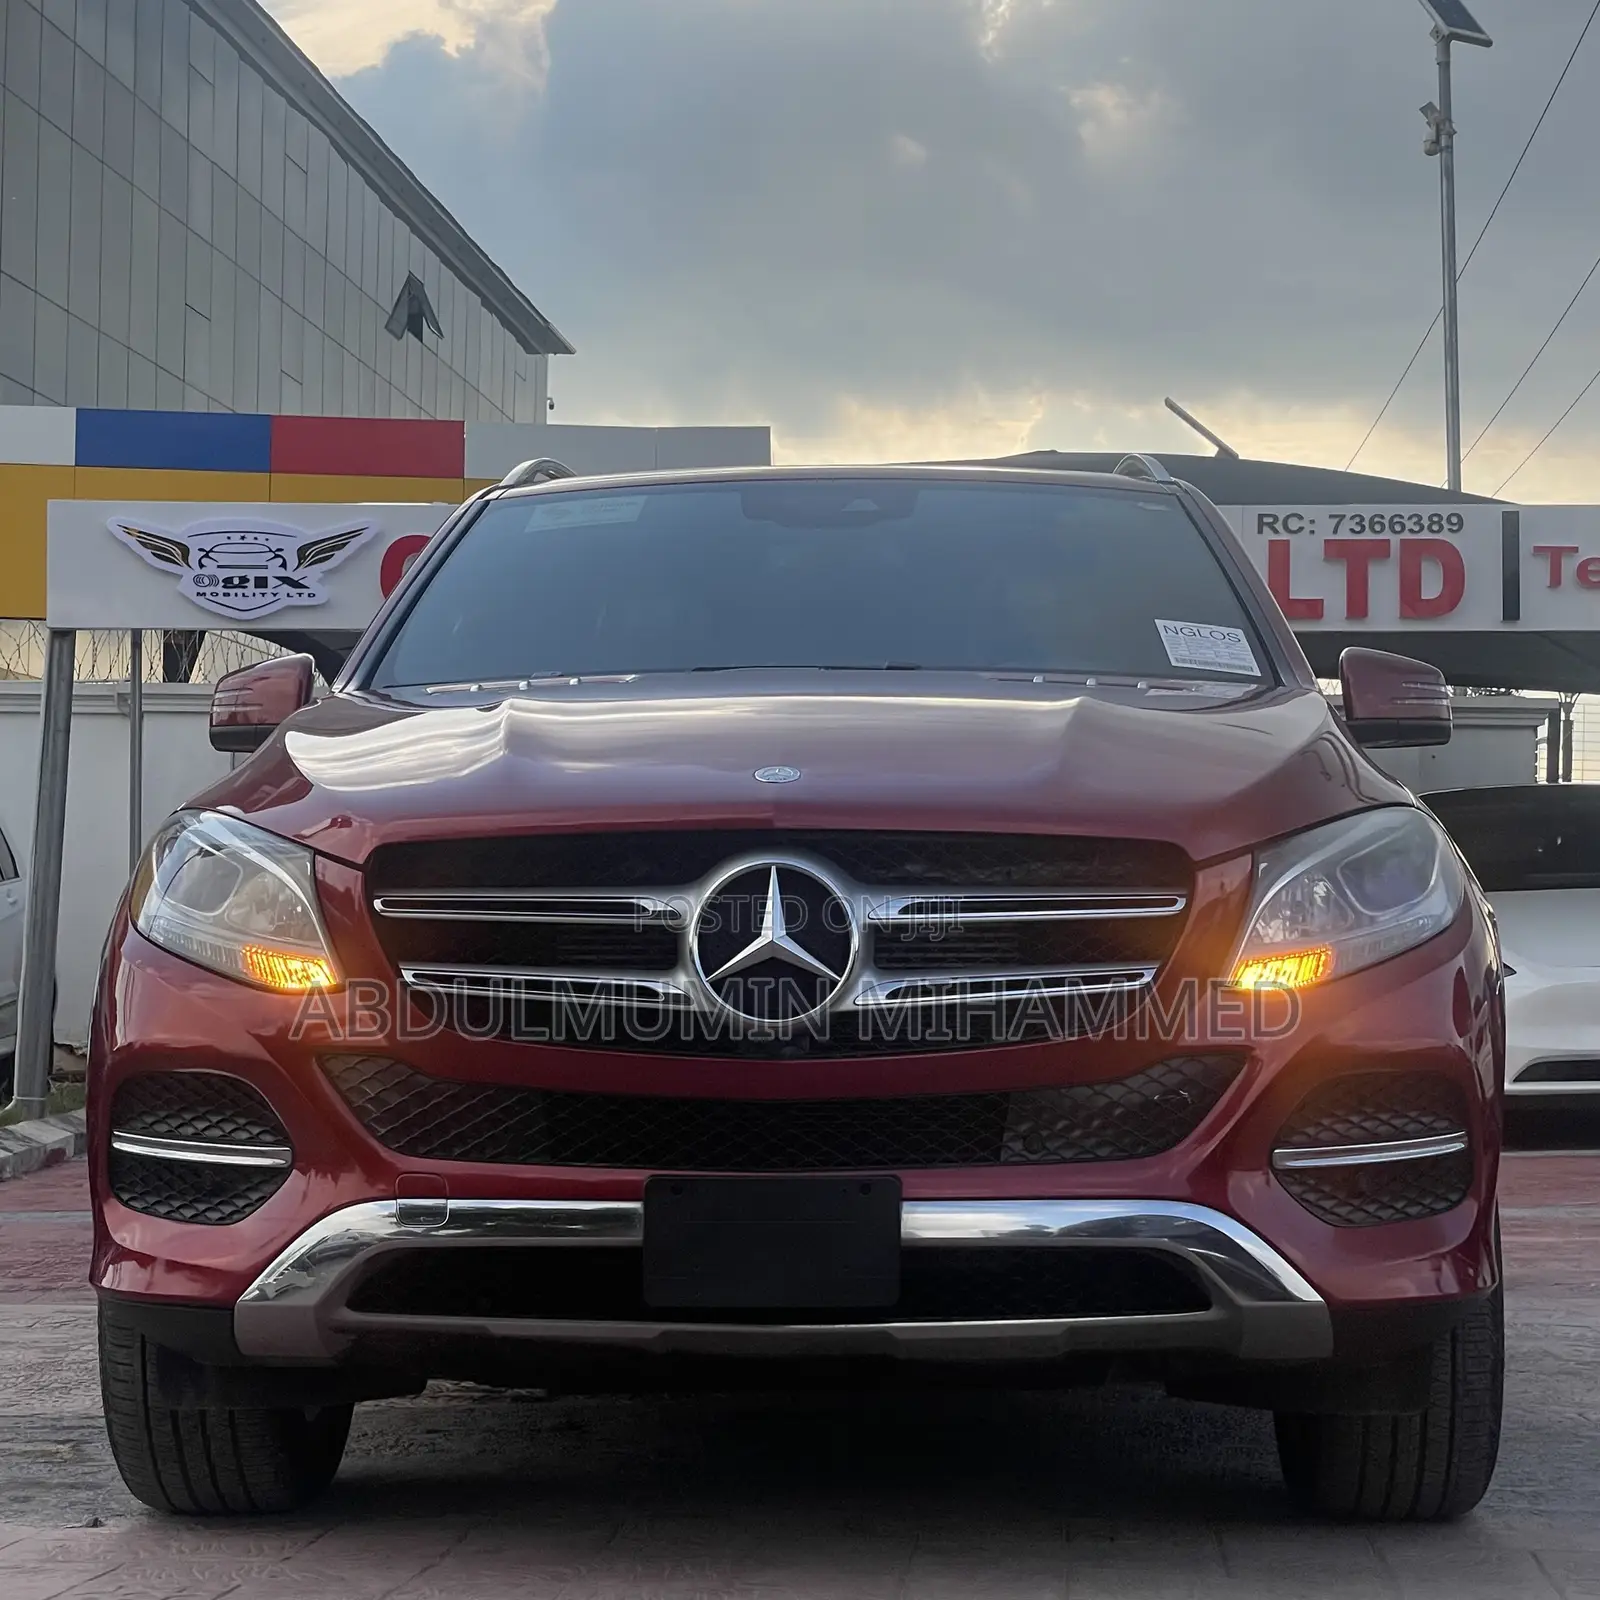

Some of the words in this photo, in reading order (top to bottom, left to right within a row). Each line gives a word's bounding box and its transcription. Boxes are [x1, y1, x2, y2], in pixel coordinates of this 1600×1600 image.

[1257, 513, 1316, 534] RC:
[1328, 512, 1464, 534] 7366389
[1268, 538, 1466, 620] LTD
[1163, 625, 1241, 642] NGLOS
